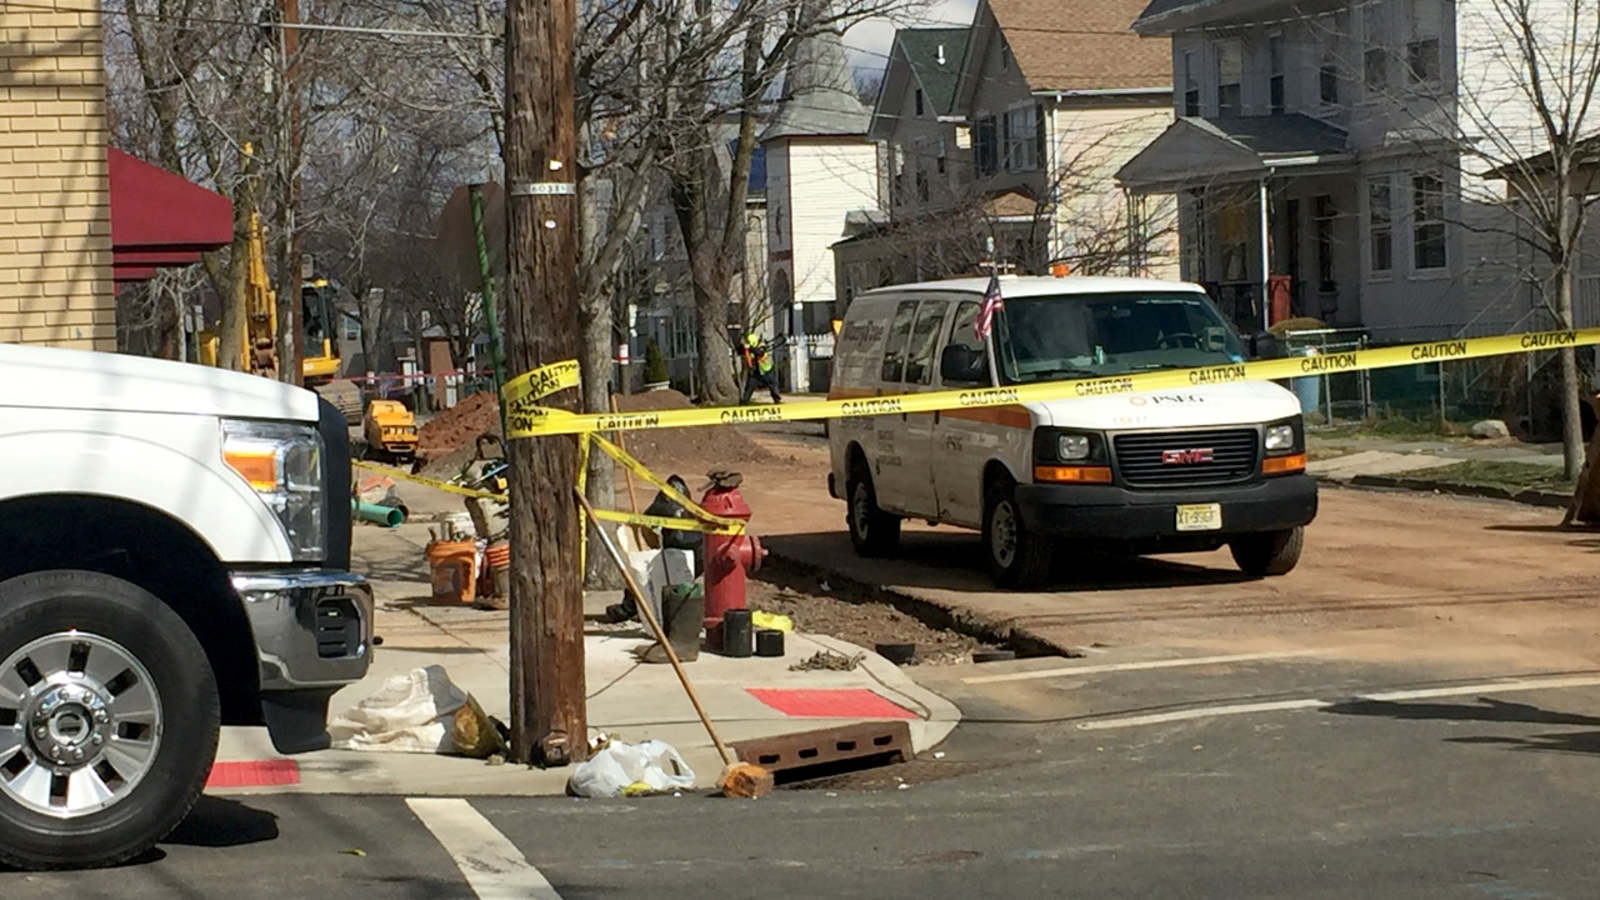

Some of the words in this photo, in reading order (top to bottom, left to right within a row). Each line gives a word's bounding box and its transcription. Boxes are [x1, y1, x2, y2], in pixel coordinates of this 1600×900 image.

[529, 363, 577, 389] CAUT
[720, 407, 783, 423] CAUTION
[841, 398, 903, 416] CAUTION
[959, 389, 1019, 406] CAUTION
[1075, 377, 1134, 397] CAUTION
[1188, 366, 1246, 385] CAUTION
[1300, 354, 1357, 373] CAUTION
[1411, 342, 1467, 360] CAUTION
[1520, 331, 1578, 349] CAUTION
[1162, 447, 1214, 465] GMC
